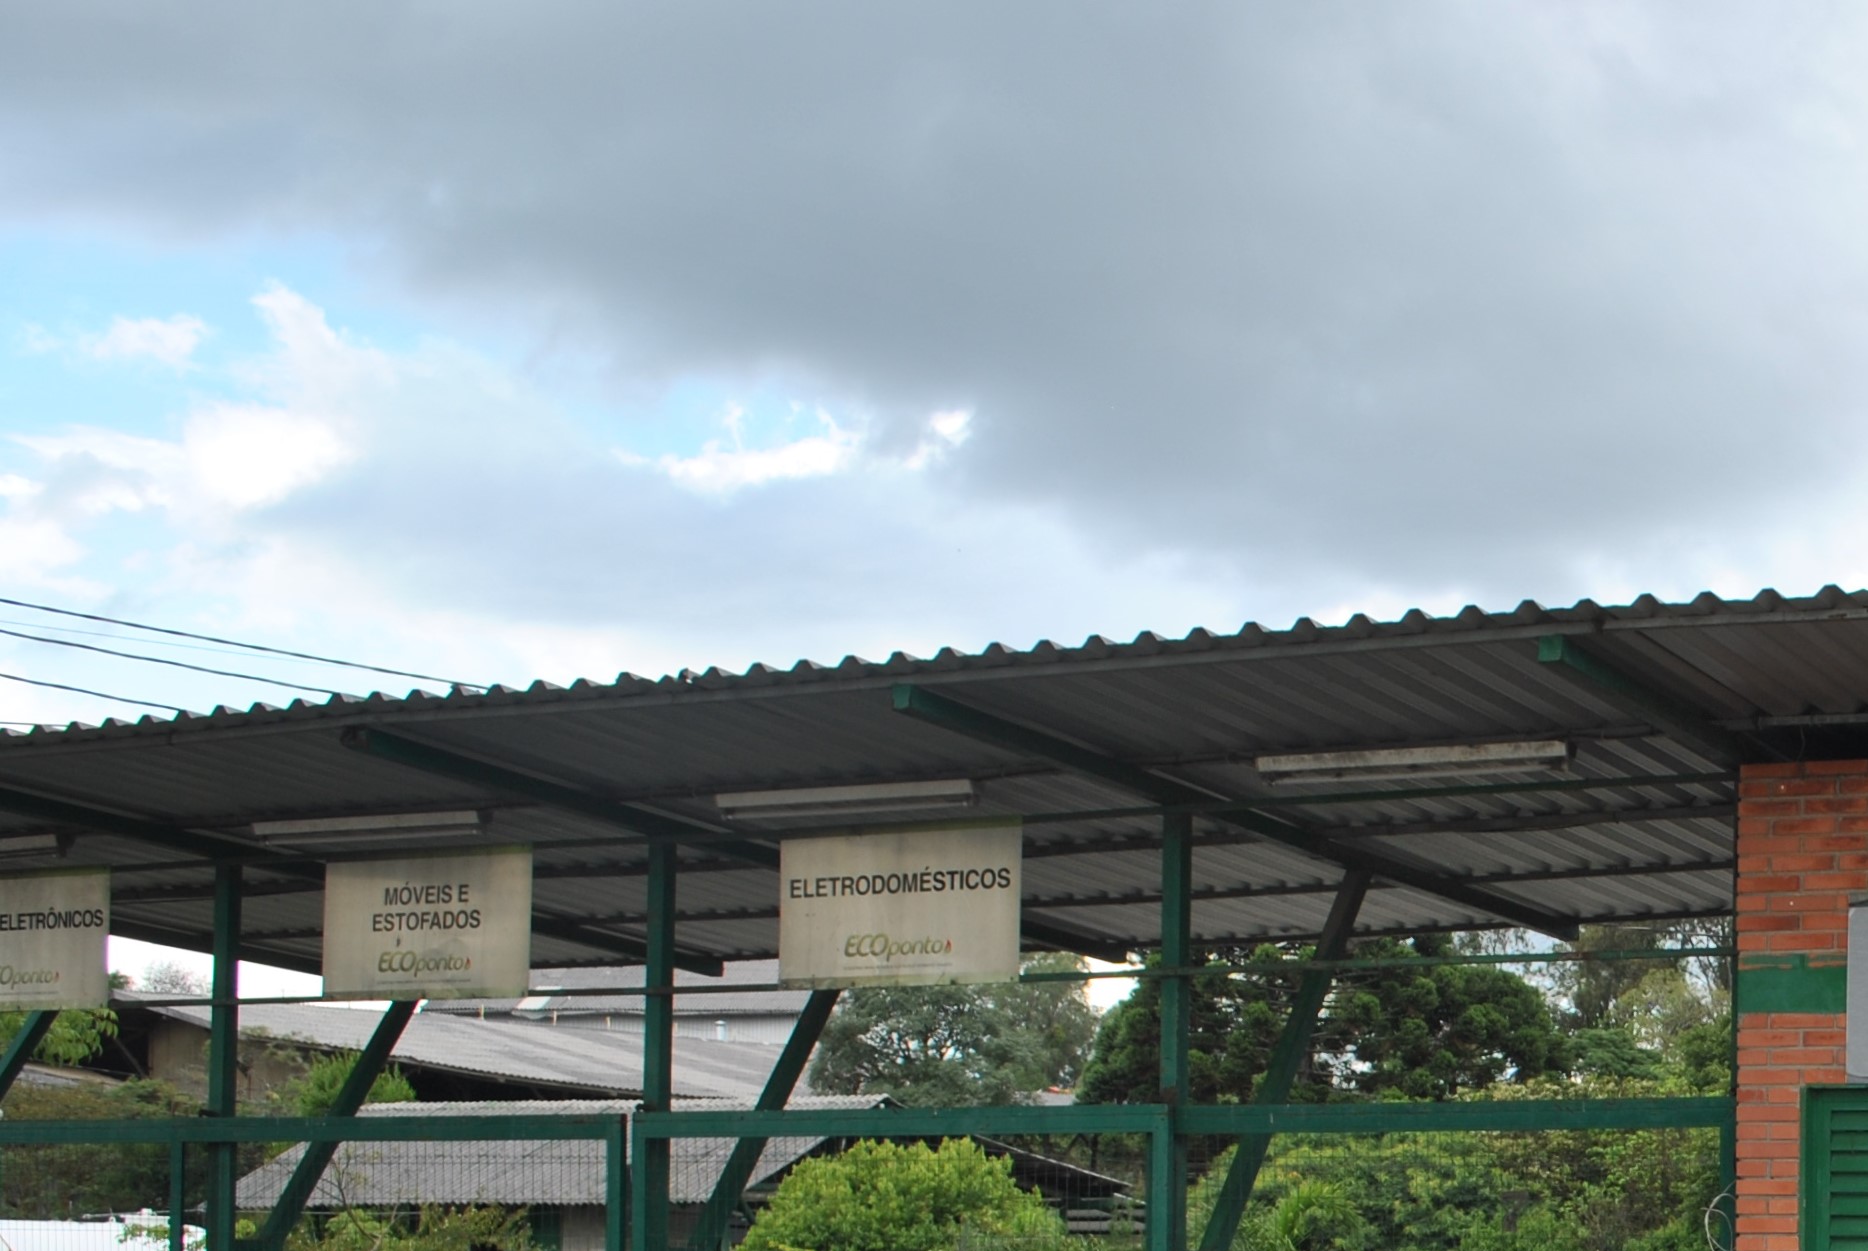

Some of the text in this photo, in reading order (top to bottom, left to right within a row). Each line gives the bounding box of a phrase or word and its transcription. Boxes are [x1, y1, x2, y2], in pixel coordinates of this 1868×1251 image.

[384, 881, 469, 906] MÓVEIS E
[790, 866, 1011, 898] ELETRODOMÉSTICOS
[372, 909, 481, 932] ESTOFADOS
[844, 933, 944, 962] ECOponto
[378, 951, 464, 978] ECOponto
